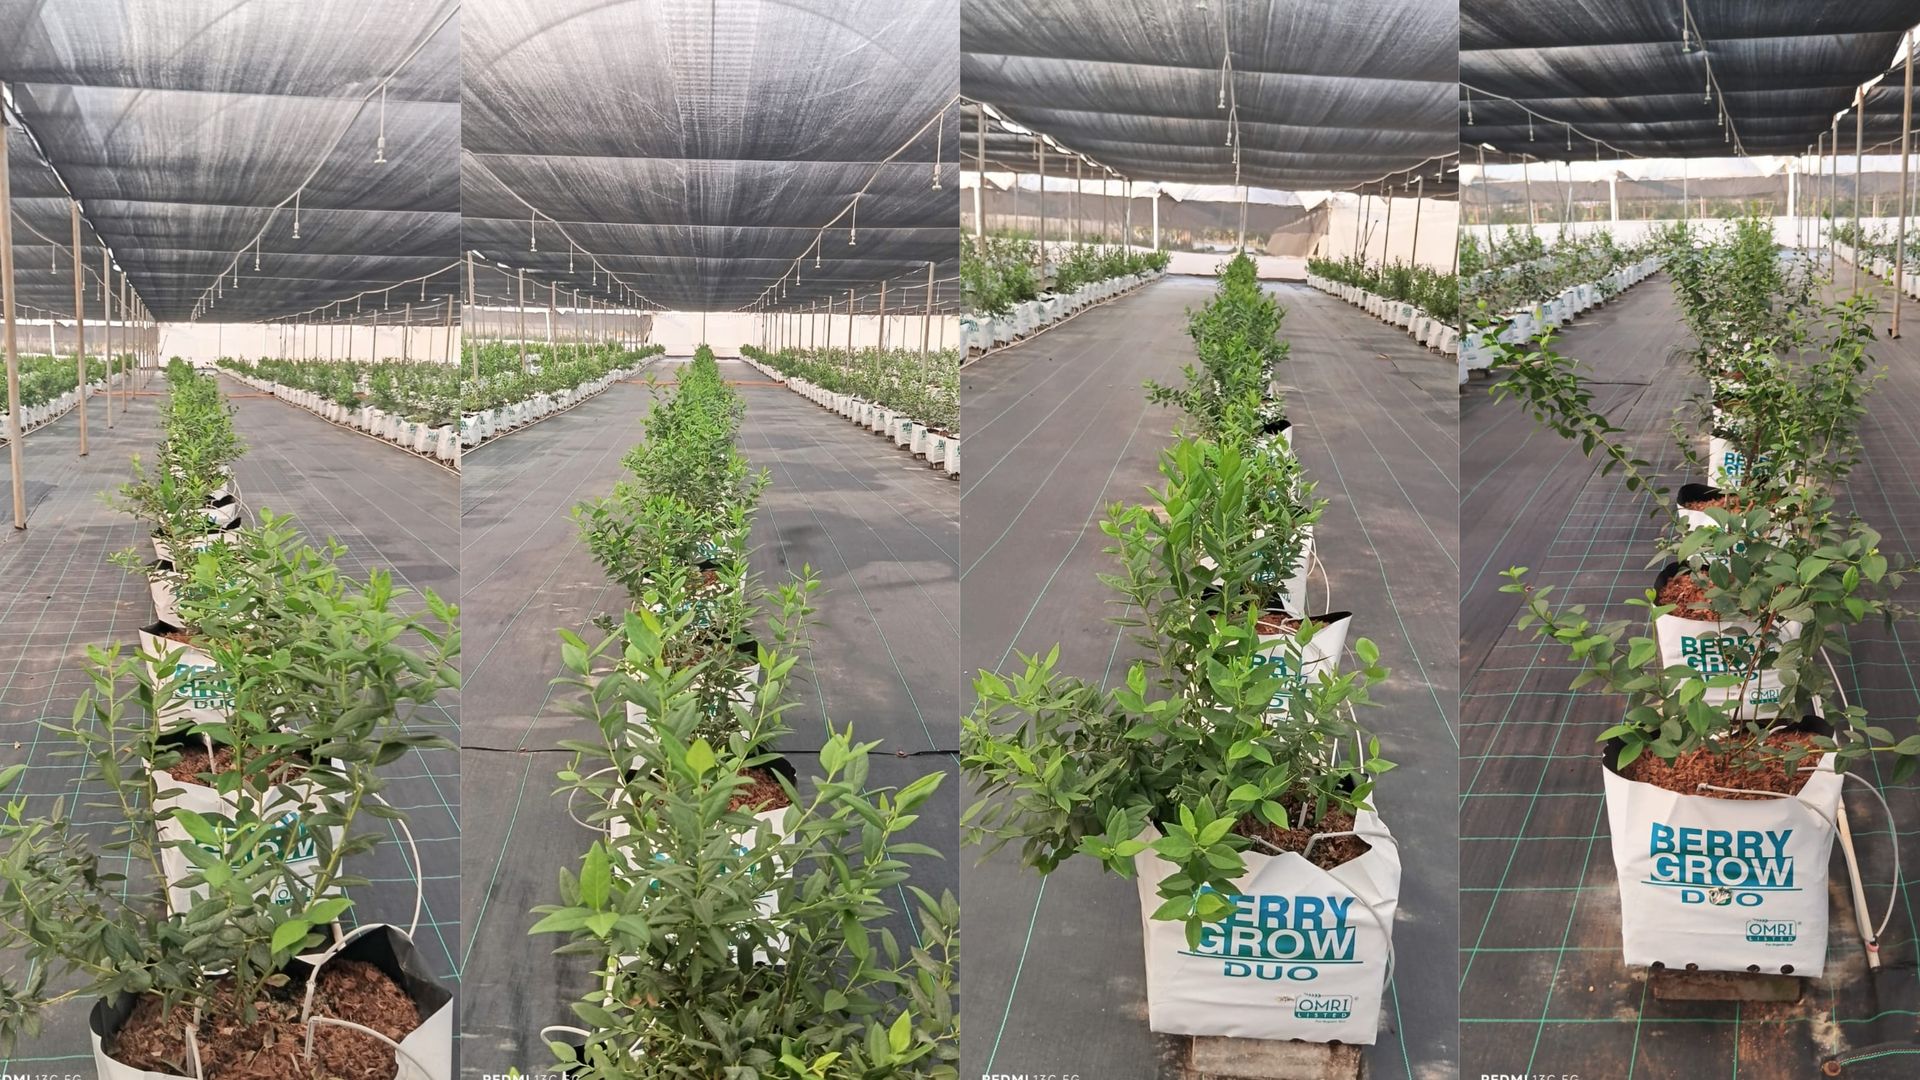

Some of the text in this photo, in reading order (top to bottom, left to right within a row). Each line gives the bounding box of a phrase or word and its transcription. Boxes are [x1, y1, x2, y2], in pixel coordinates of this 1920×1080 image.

[1650, 822, 1794, 858] BERRY
[1651, 852, 1793, 887] GROW
[1200, 885, 1356, 931] ERRY
[1197, 923, 1357, 961] GROW
[1749, 923, 1793, 936] OMRI
[1224, 961, 1319, 981] DUO
[1299, 999, 1349, 1012] OMRI
